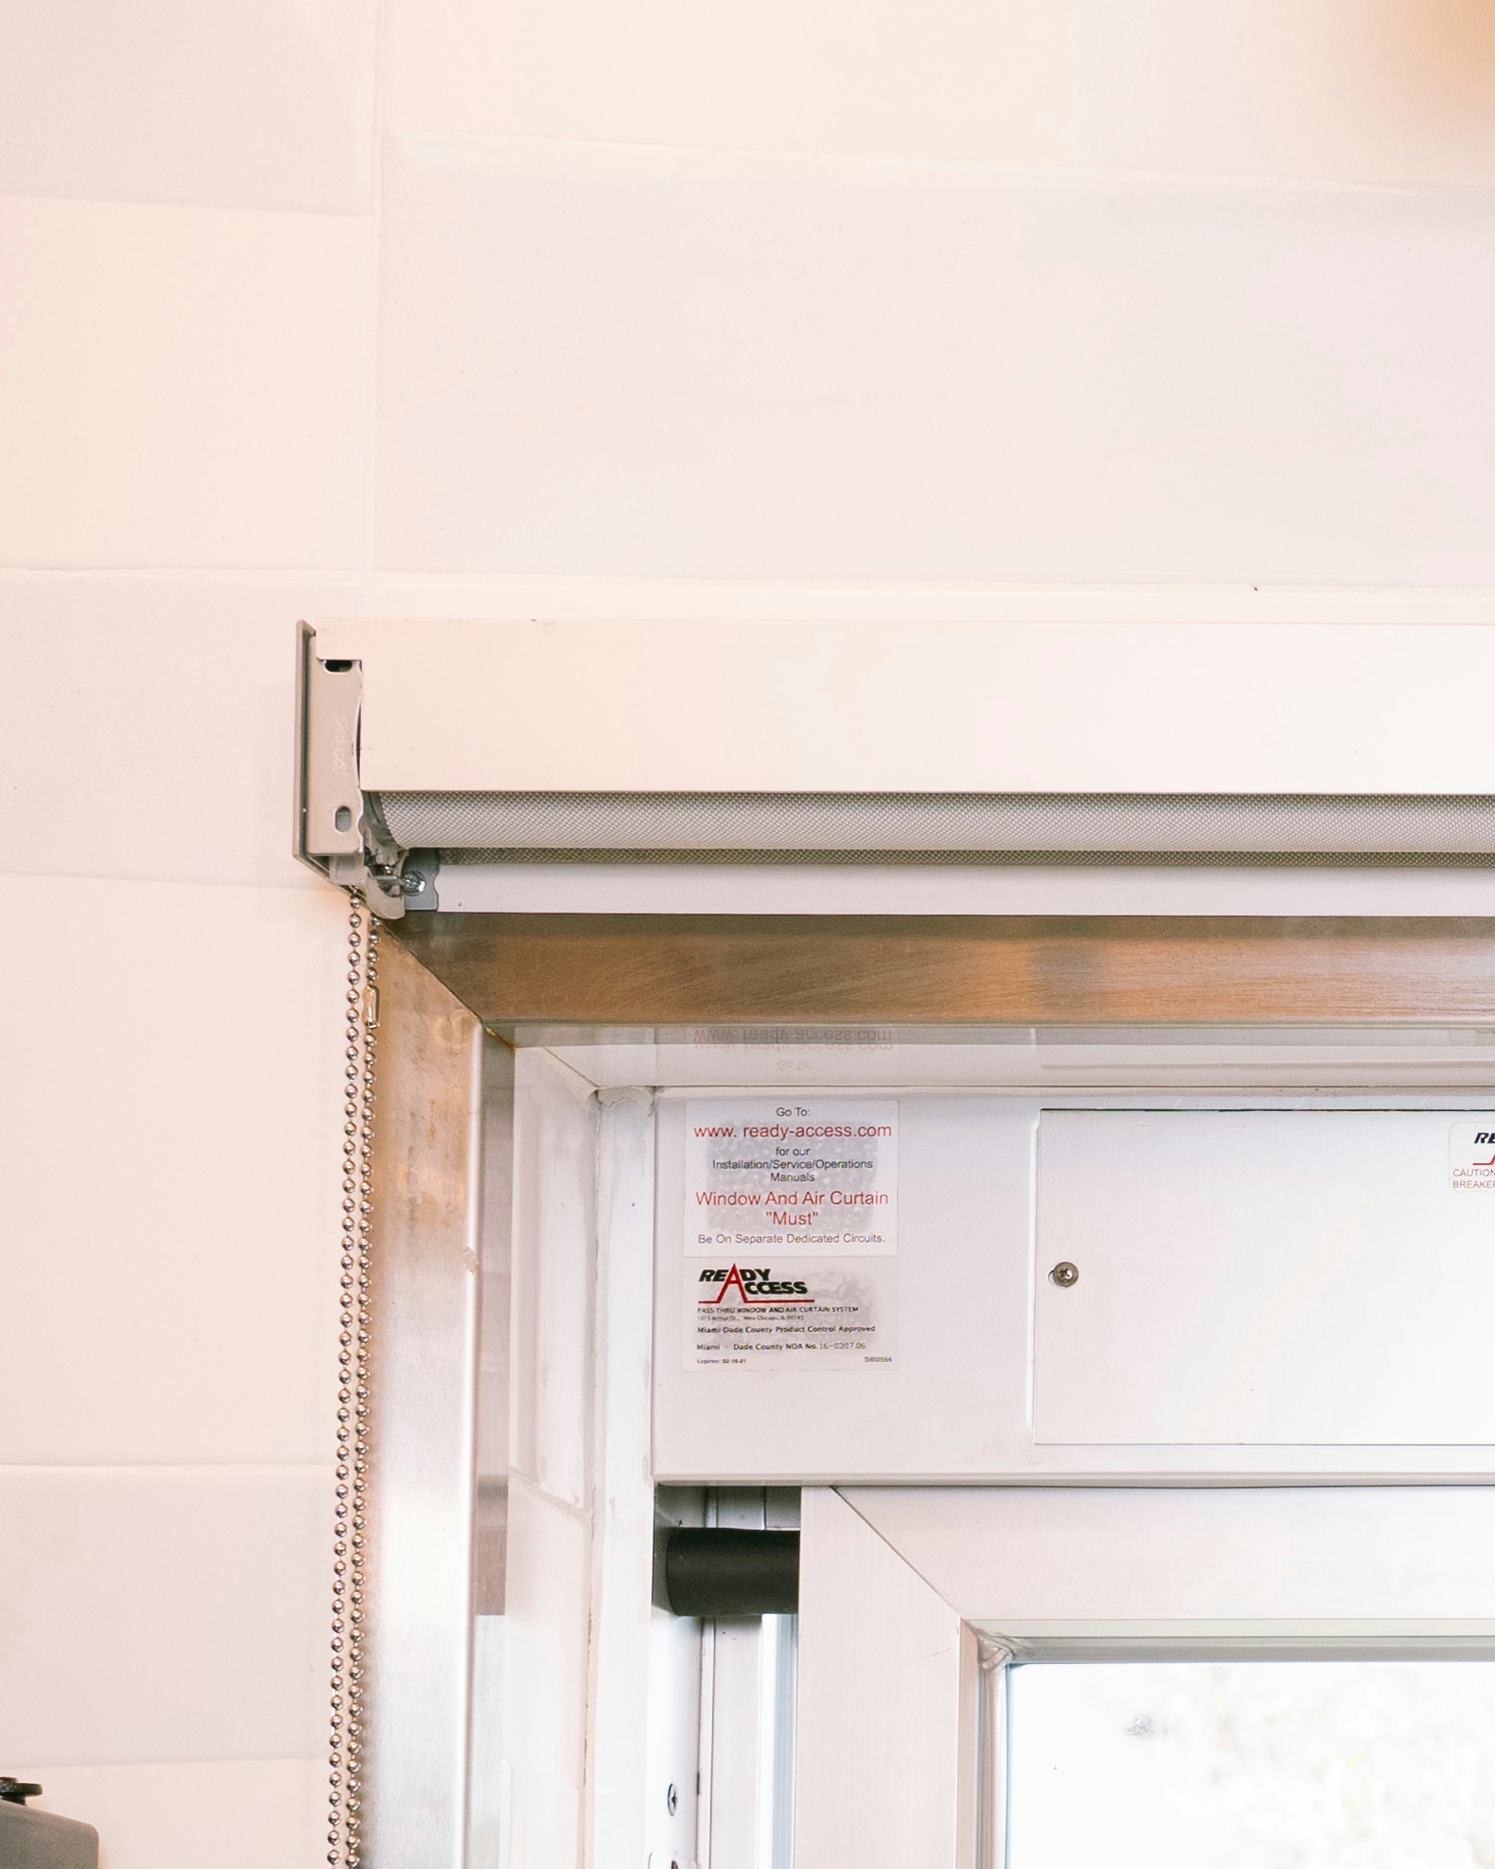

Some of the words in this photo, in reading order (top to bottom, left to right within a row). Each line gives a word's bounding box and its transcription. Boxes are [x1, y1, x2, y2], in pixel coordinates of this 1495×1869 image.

[776, 1107, 792, 1117] Go
[796, 1107, 811, 1117] To:
[693, 1126, 737, 1138] www.
[743, 1124, 892, 1141] ready-access.com
[775, 1146, 789, 1156] for
[793, 1148, 811, 1157] our
[712, 1159, 874, 1171] Installation/Service/Operations
[770, 1172, 816, 1183] Manuals
[696, 1191, 762, 1206] Window
[765, 1190, 798, 1206] And
[802, 1190, 826, 1205] Air
[830, 1189, 889, 1205] Curtain
[766, 1210, 819, 1226] "Must"
[698, 1234, 713, 1245] Be
[716, 1234, 733, 1244] On
[735, 1234, 784, 1246] Separate
[787, 1233, 841, 1244] Dedicated
[843, 1233, 887, 1244] Circuits.
[699, 1263, 771, 1284] READY
[839, 1325, 876, 1334] Approved
